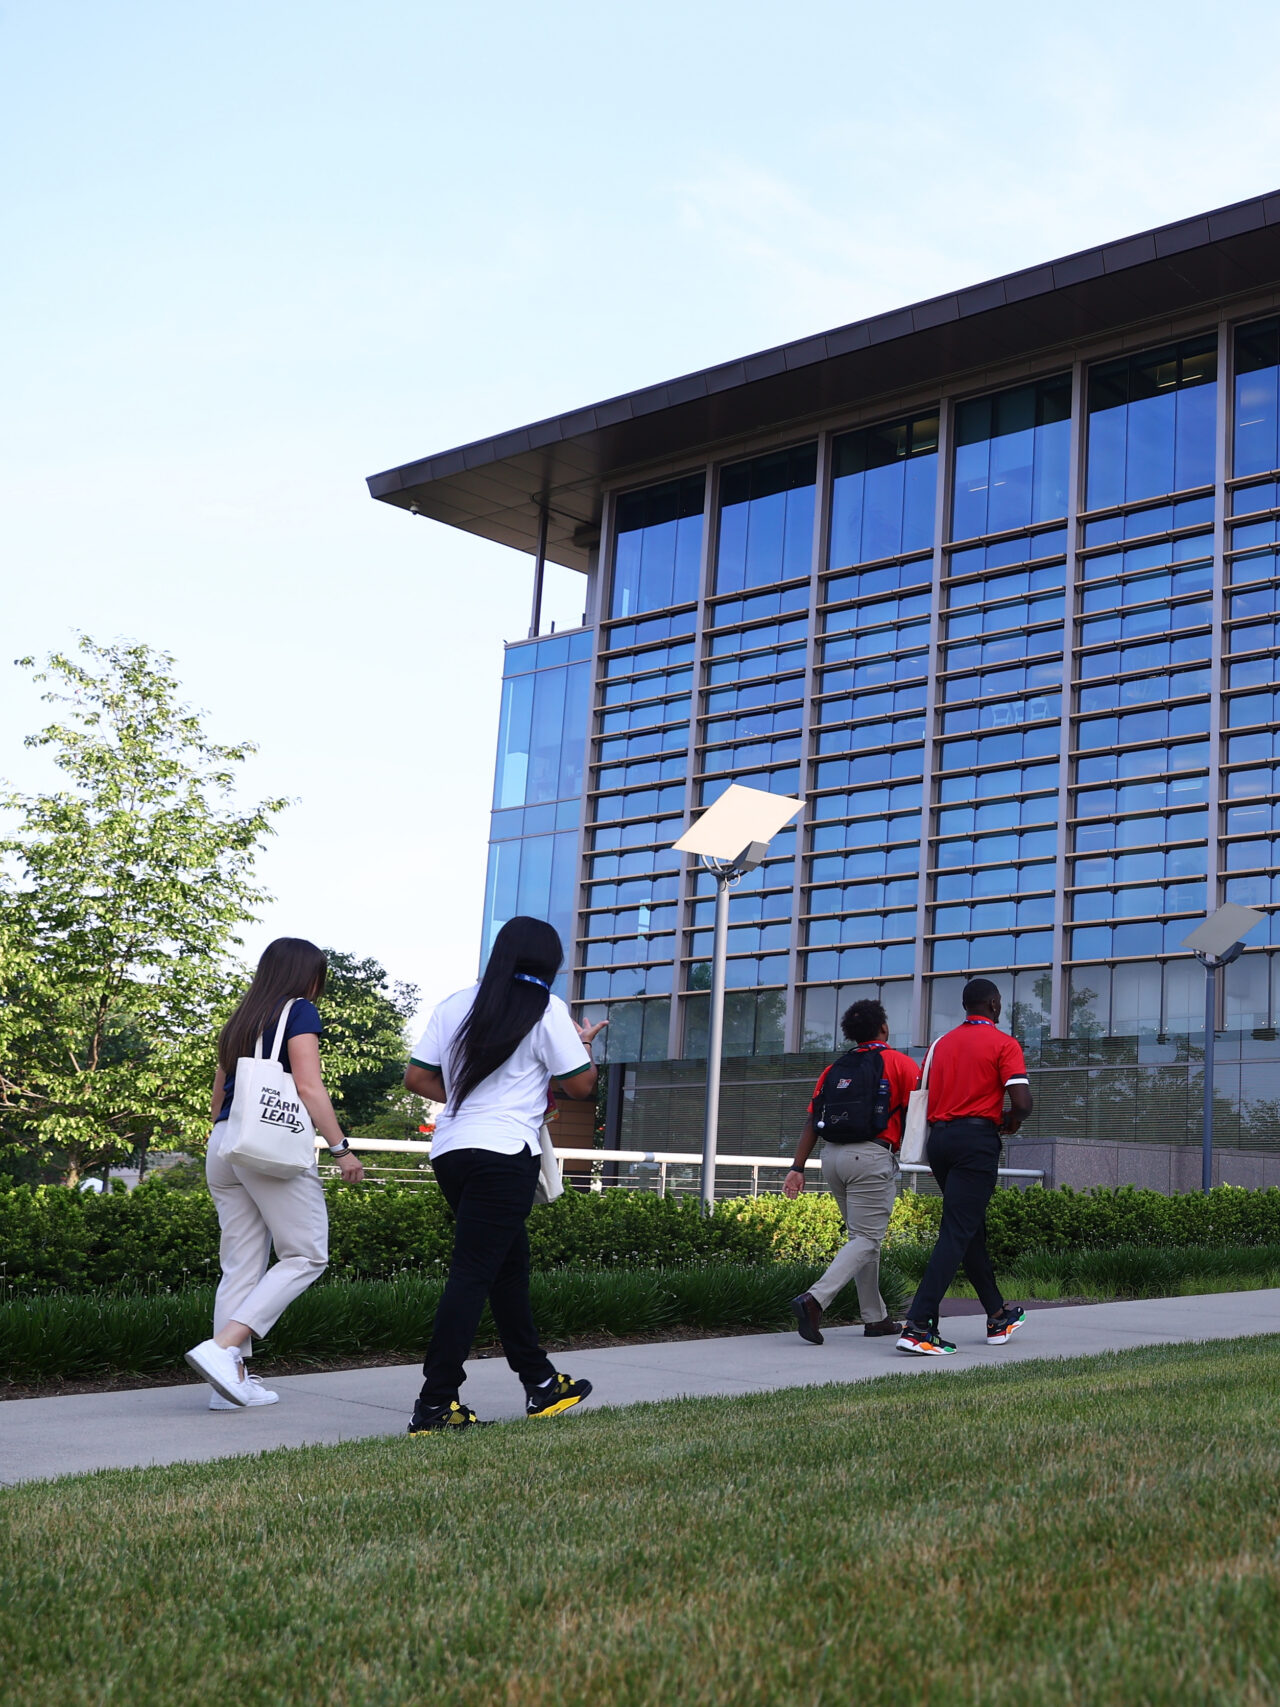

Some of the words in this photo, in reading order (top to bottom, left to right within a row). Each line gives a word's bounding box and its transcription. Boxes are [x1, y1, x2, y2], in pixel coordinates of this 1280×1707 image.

[261, 1087, 280, 1096] NCAA
[259, 1094, 299, 1113] LEARN
[261, 1108, 296, 1125] LEAD
